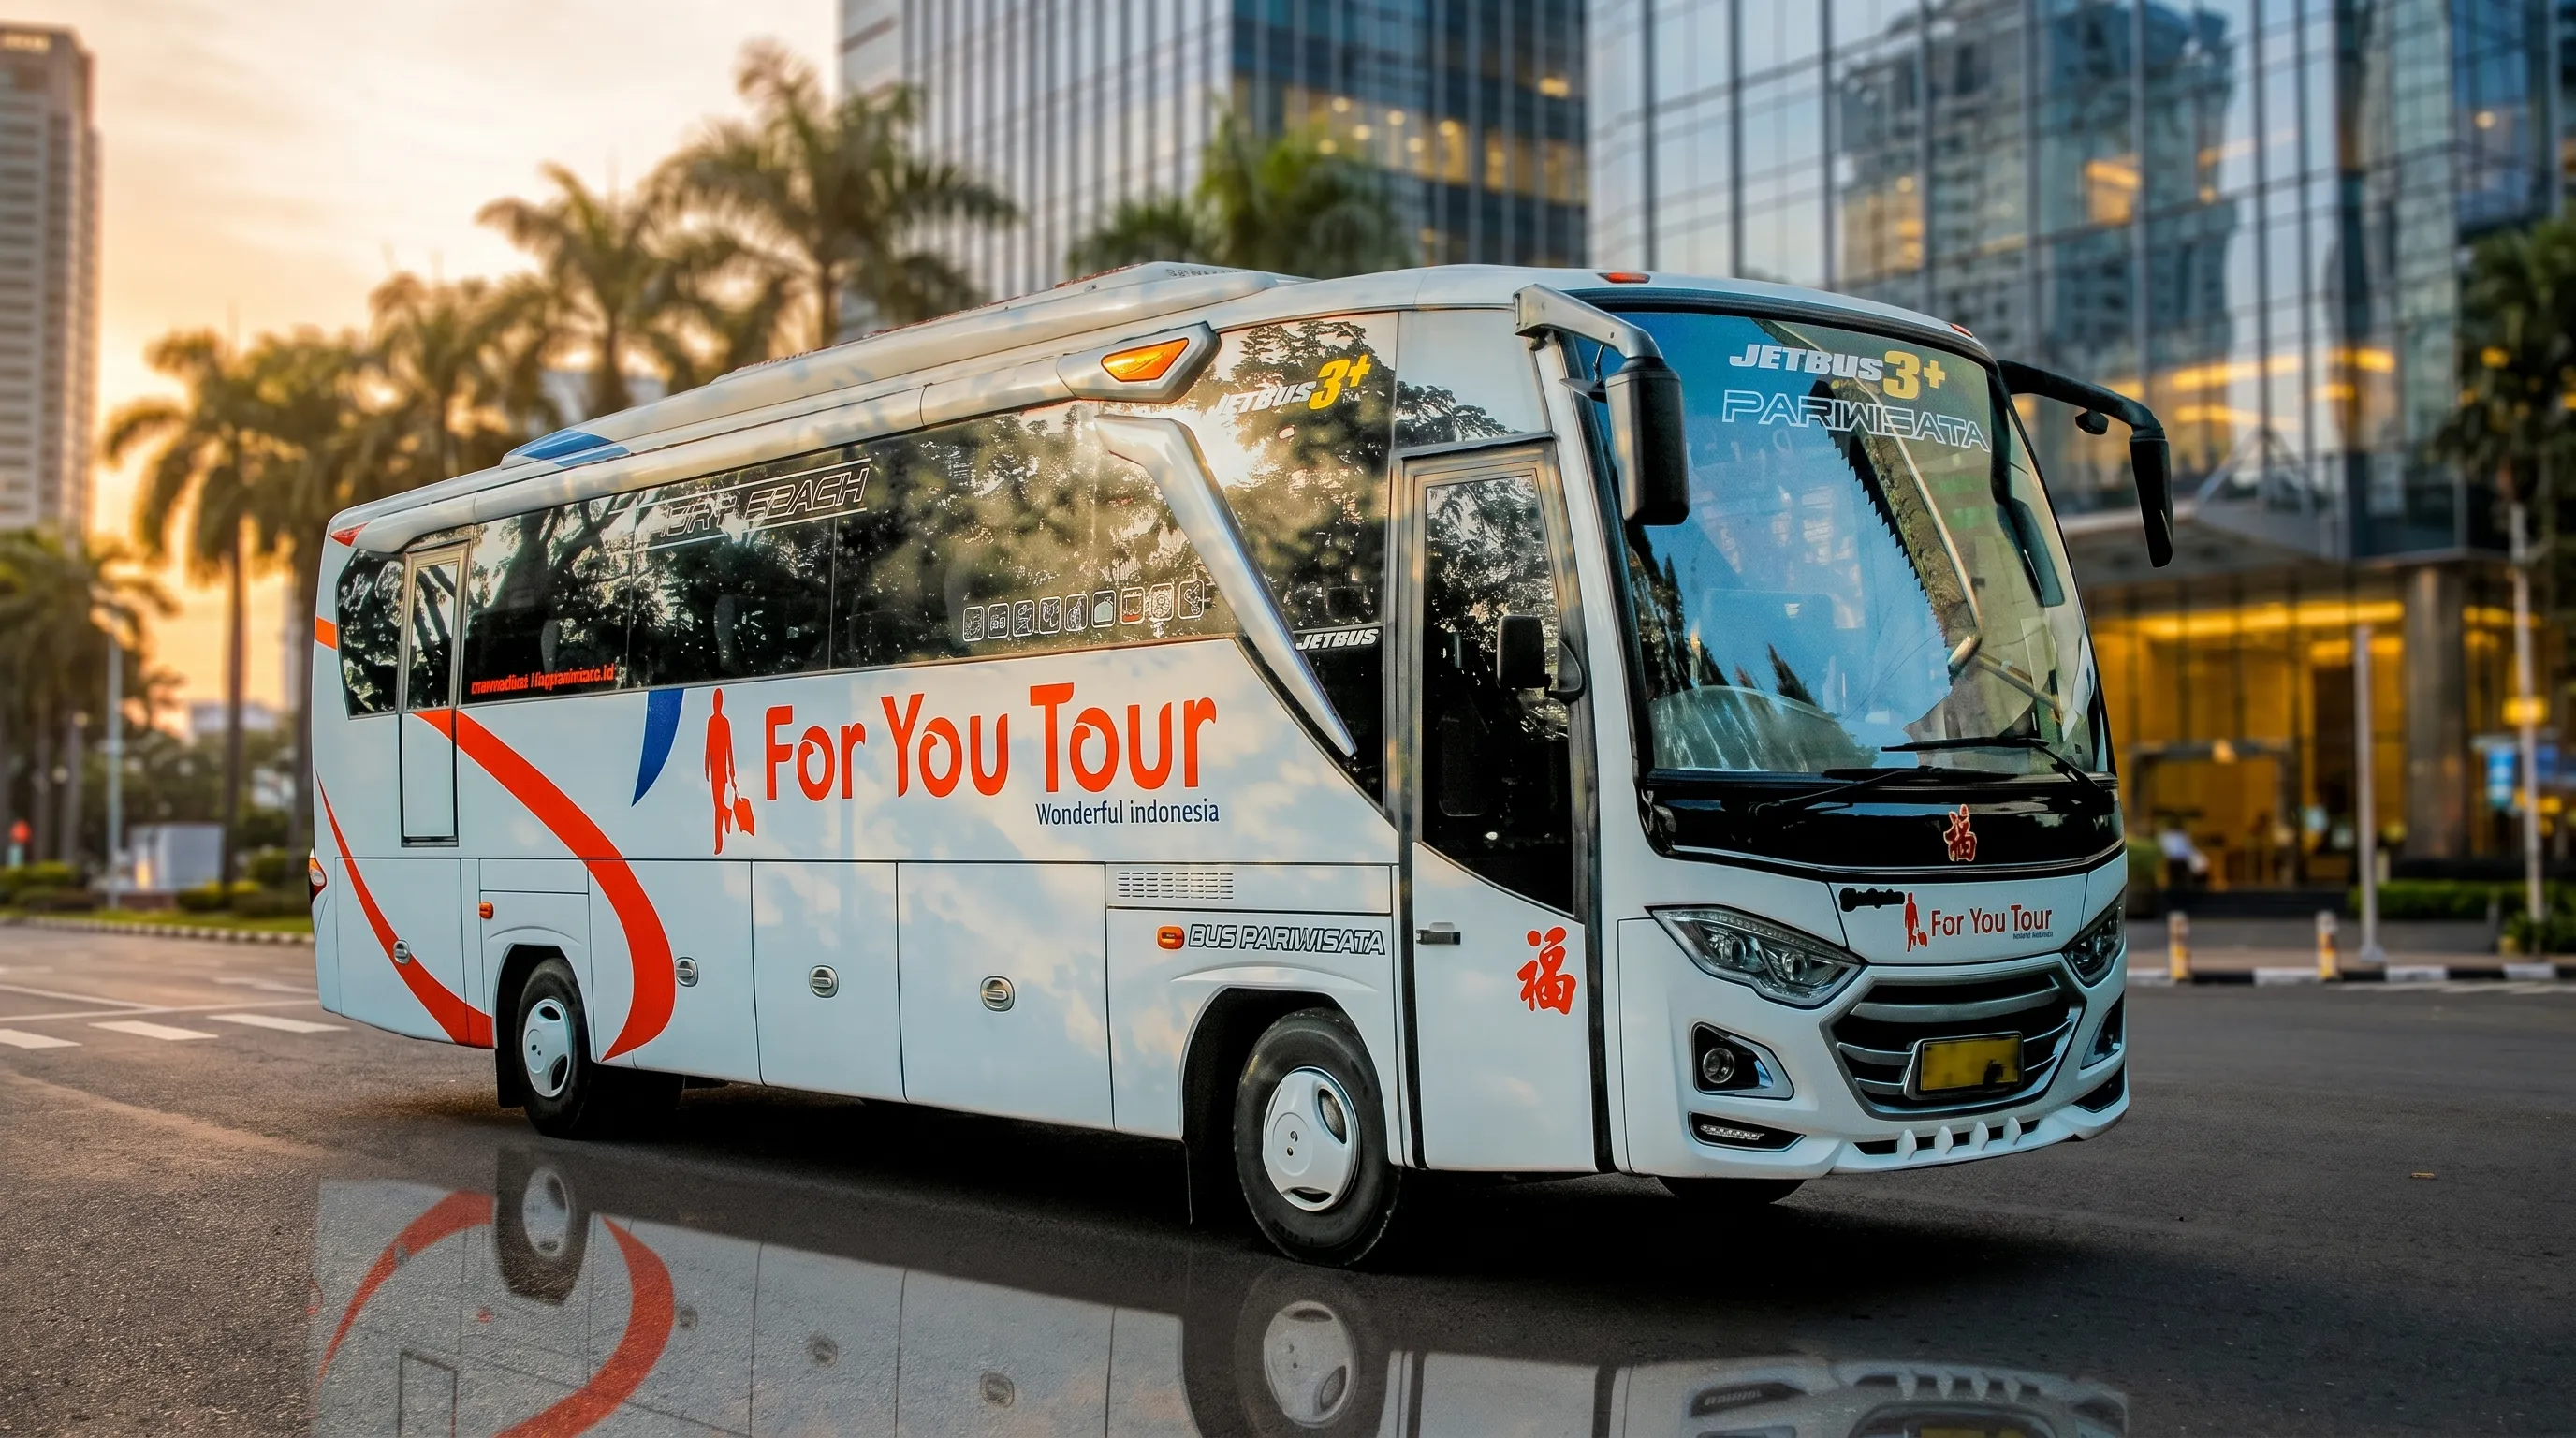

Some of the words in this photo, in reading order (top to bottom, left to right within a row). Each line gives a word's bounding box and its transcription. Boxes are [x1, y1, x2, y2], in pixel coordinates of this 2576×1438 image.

[1722, 389, 1991, 452] PARIWISATA
[1295, 628, 1379, 651] JETBUS
[765, 704, 866, 801] For
[880, 693, 1008, 798] You
[1030, 682, 1217, 793] Tour
[1035, 800, 1123, 826] Wonderful
[1930, 909, 1964, 937] For
[1969, 908, 2006, 934] You
[2010, 904, 2053, 932] Tour
[1188, 923, 1237, 949] BUS
[1238, 925, 1386, 955] PARIWISATA
[1515, 925, 1577, 1016] 福
